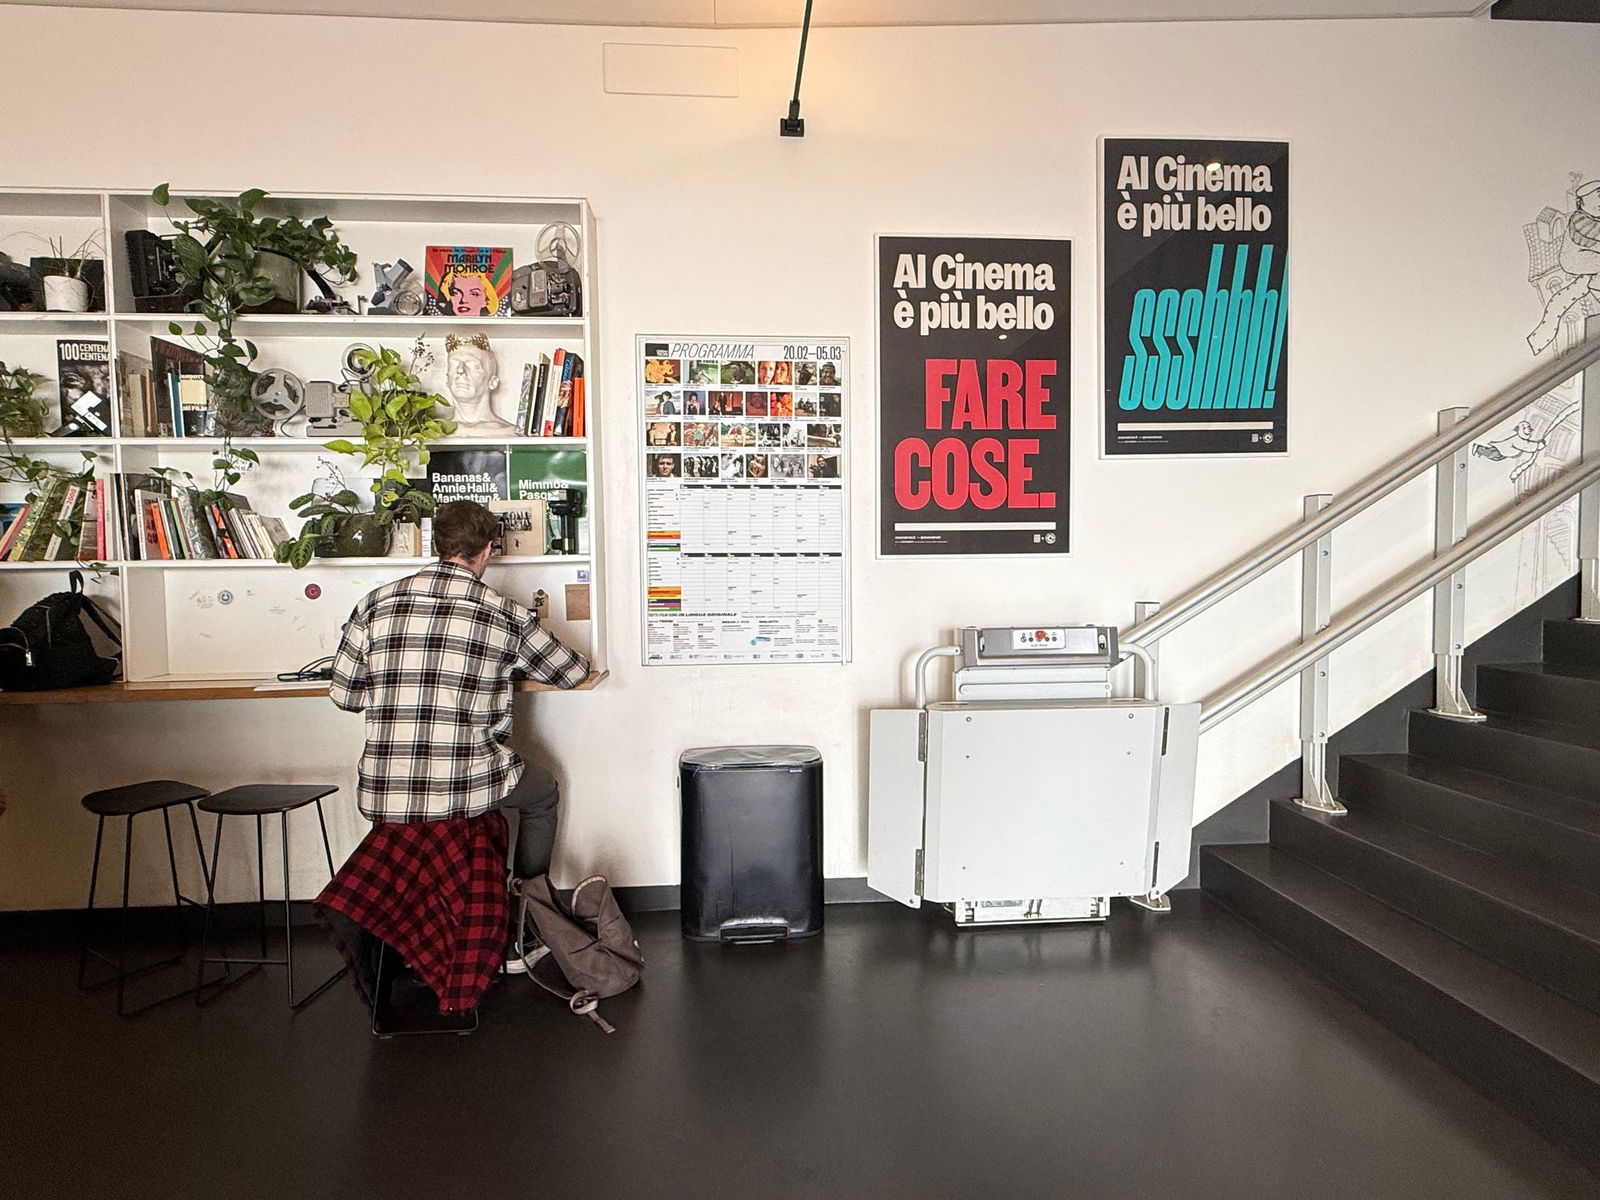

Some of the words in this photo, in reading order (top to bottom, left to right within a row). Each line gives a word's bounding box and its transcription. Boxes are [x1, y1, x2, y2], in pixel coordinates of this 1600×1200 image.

[1117, 156, 1149, 190] Al
[1155, 155, 1272, 192] Cinema
[1117, 191, 1137, 230] è
[1143, 192, 1191, 237] più
[1197, 196, 1271, 231] bello
[444, 264, 495, 273] MONROE
[447, 254, 492, 263] MARILYN
[893, 254, 926, 288] Al
[932, 253, 1055, 291] Cinema
[893, 290, 914, 328] è
[920, 291, 970, 335] più
[977, 295, 1054, 330] bello
[59, 343, 80, 360] 100
[670, 343, 755, 360] PROGRAMMA
[925, 359, 1056, 429] FARE
[432, 472, 491, 483] Bananas&
[894, 437, 1056, 510] COSE.
